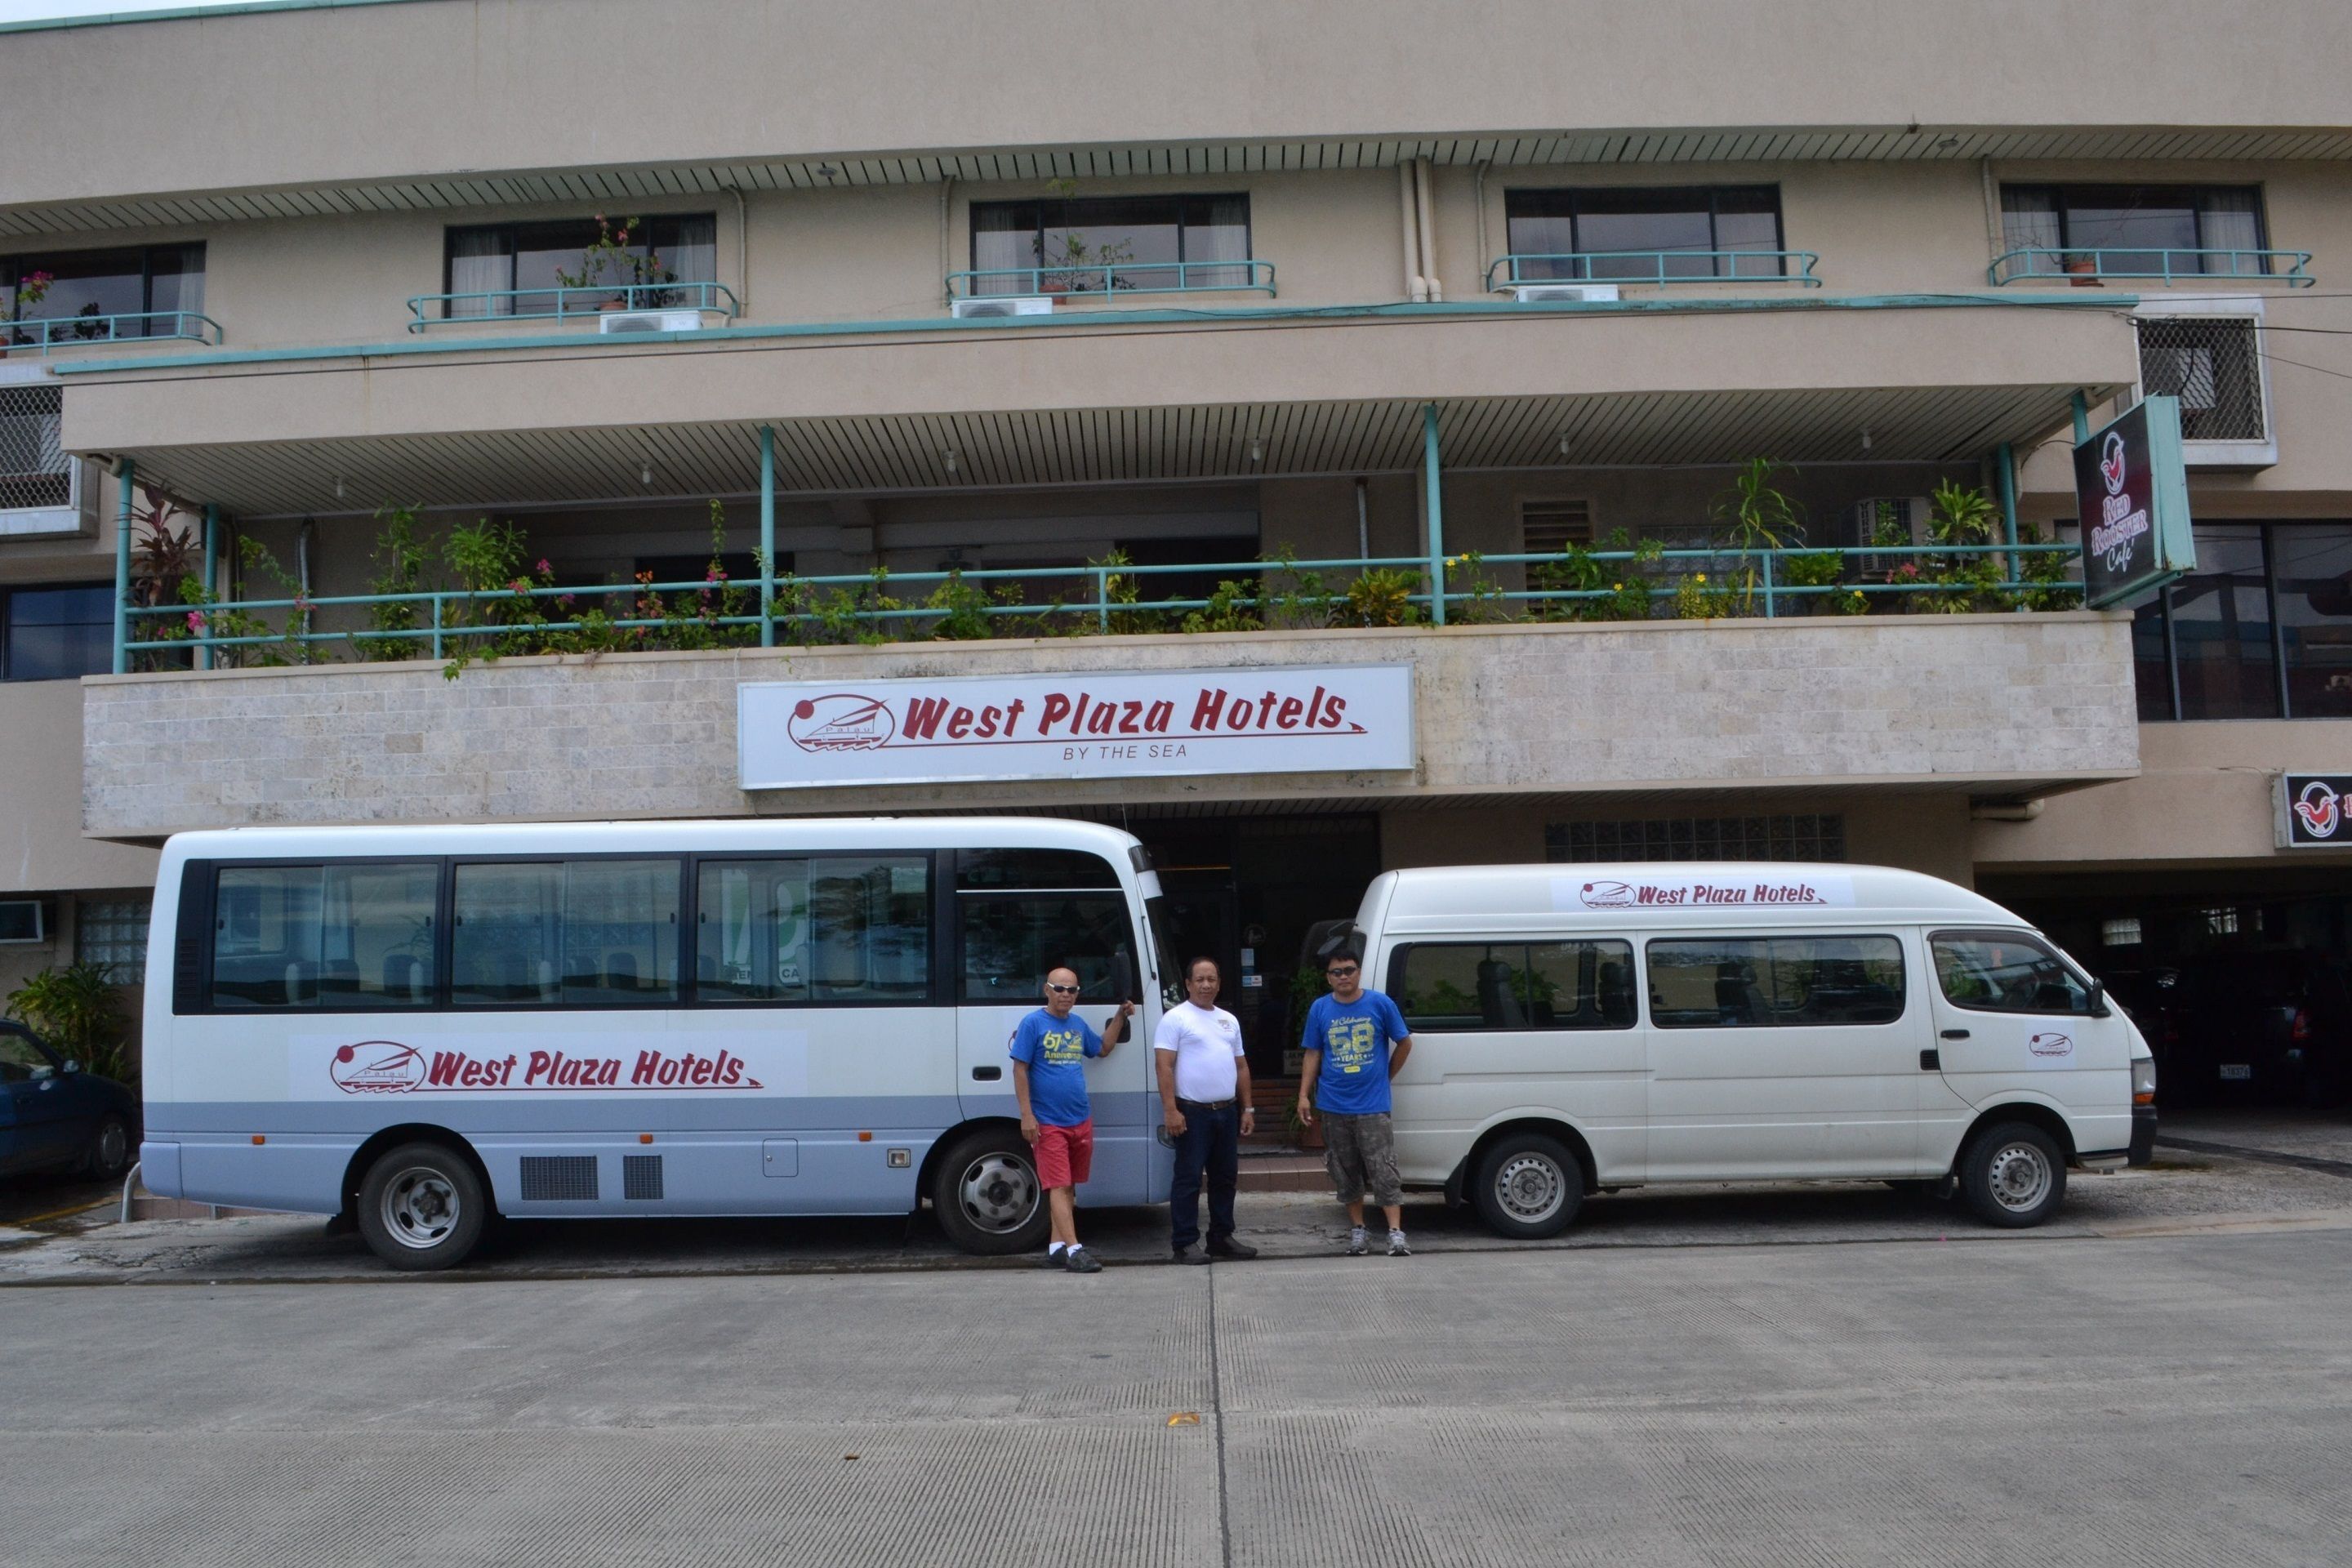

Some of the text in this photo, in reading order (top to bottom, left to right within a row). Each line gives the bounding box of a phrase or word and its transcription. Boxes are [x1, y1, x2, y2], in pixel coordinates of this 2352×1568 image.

[902, 685, 1347, 740] West Plaza Hotels
[1063, 744, 1187, 760] BY THE SEA
[1637, 884, 1815, 905] West Plaza Hotels
[428, 1049, 745, 1087] West Plaza Hotels
